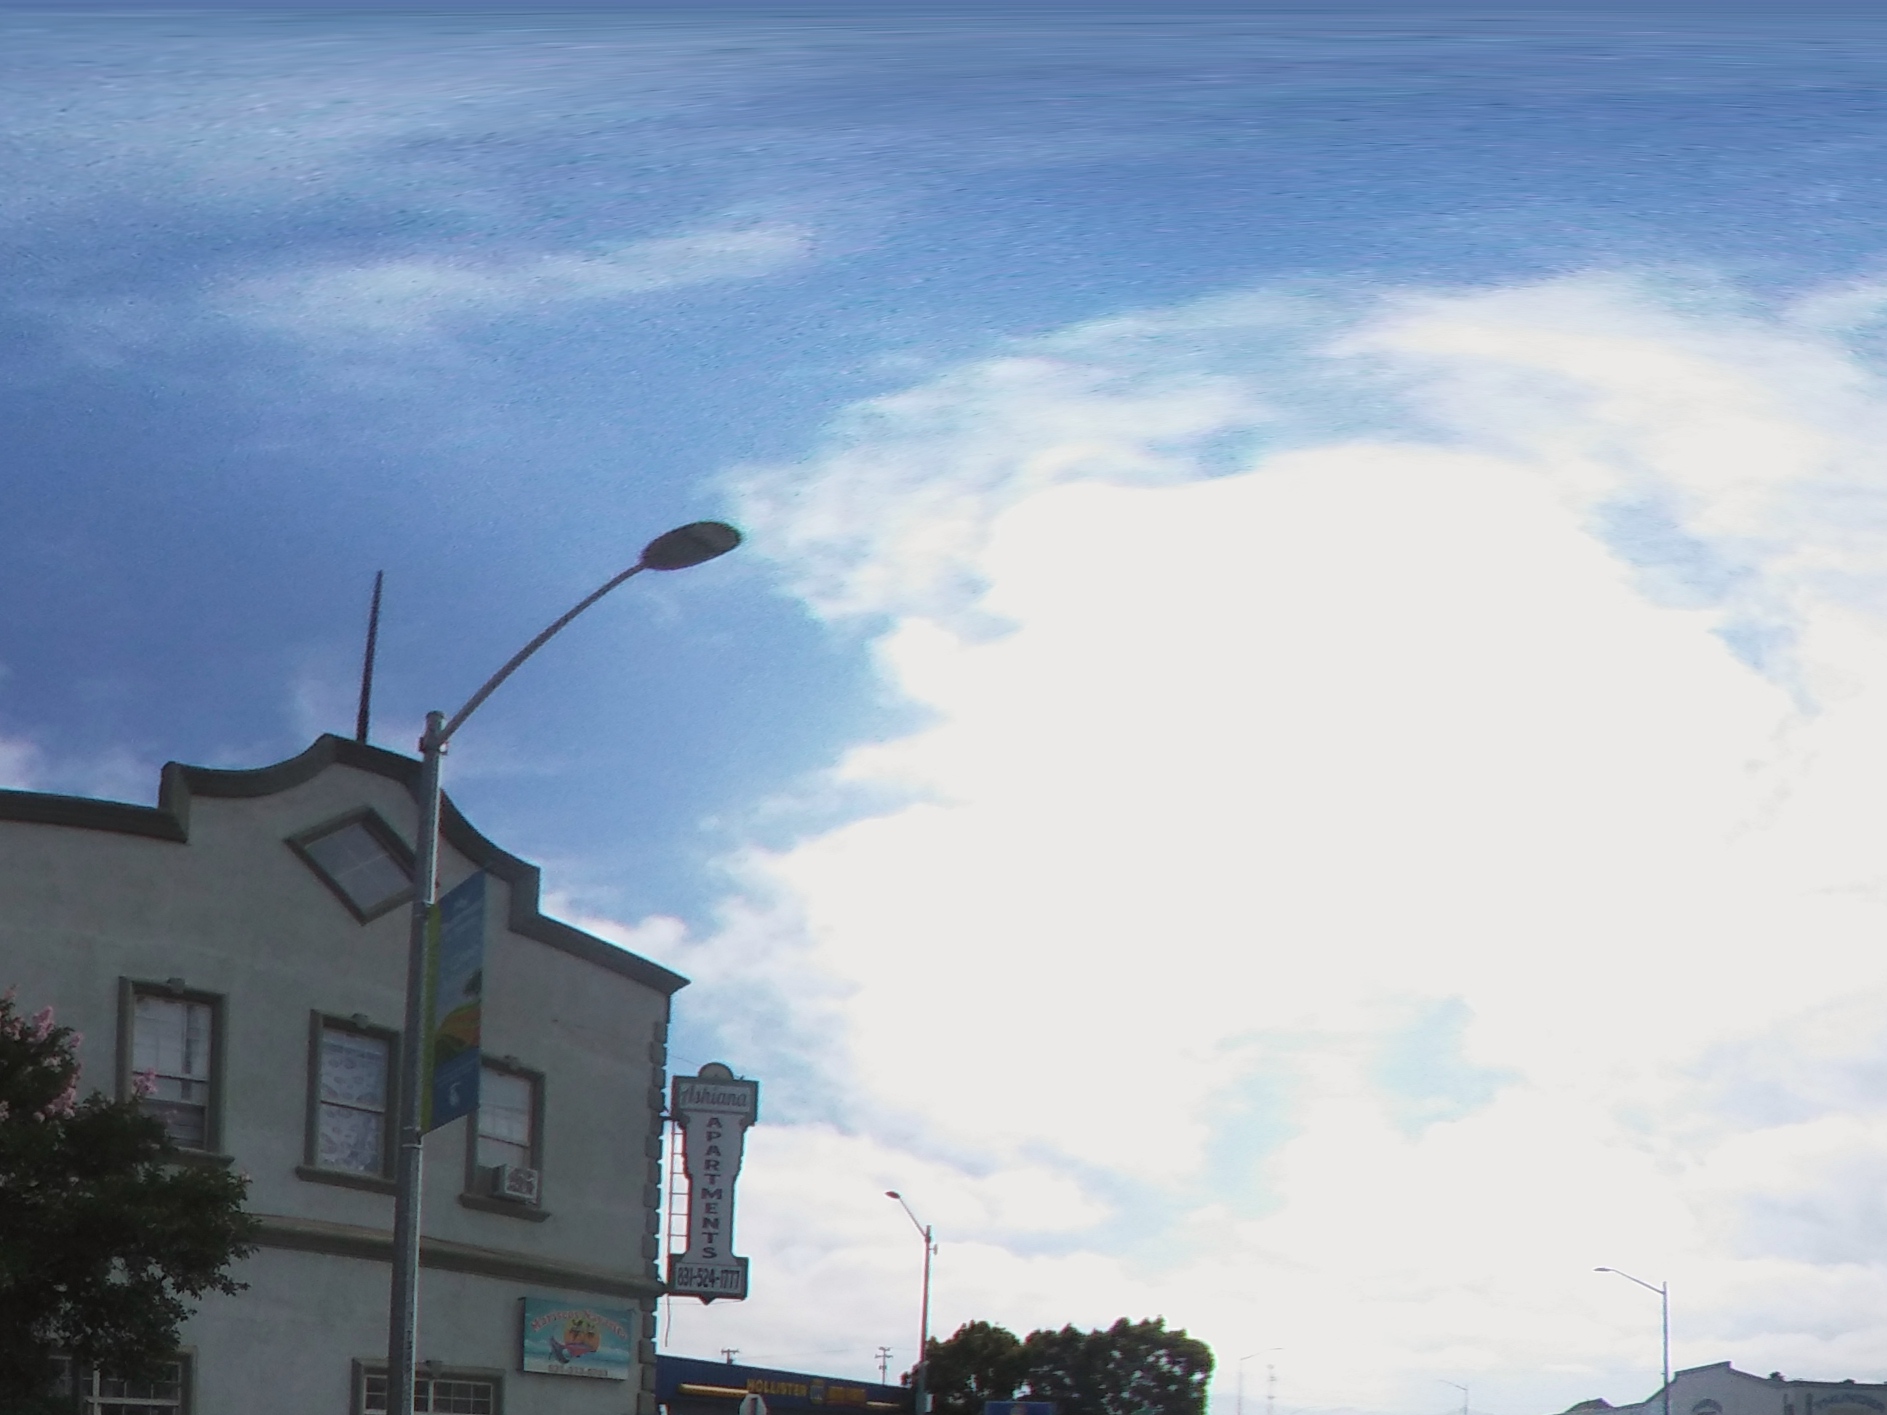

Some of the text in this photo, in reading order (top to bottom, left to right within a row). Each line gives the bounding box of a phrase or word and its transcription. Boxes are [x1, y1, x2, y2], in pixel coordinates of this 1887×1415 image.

[681, 1082, 748, 1108] Ashiana
[700, 1117, 723, 1259] APARTMENTS
[677, 1266, 740, 1288] 831-524-1777
